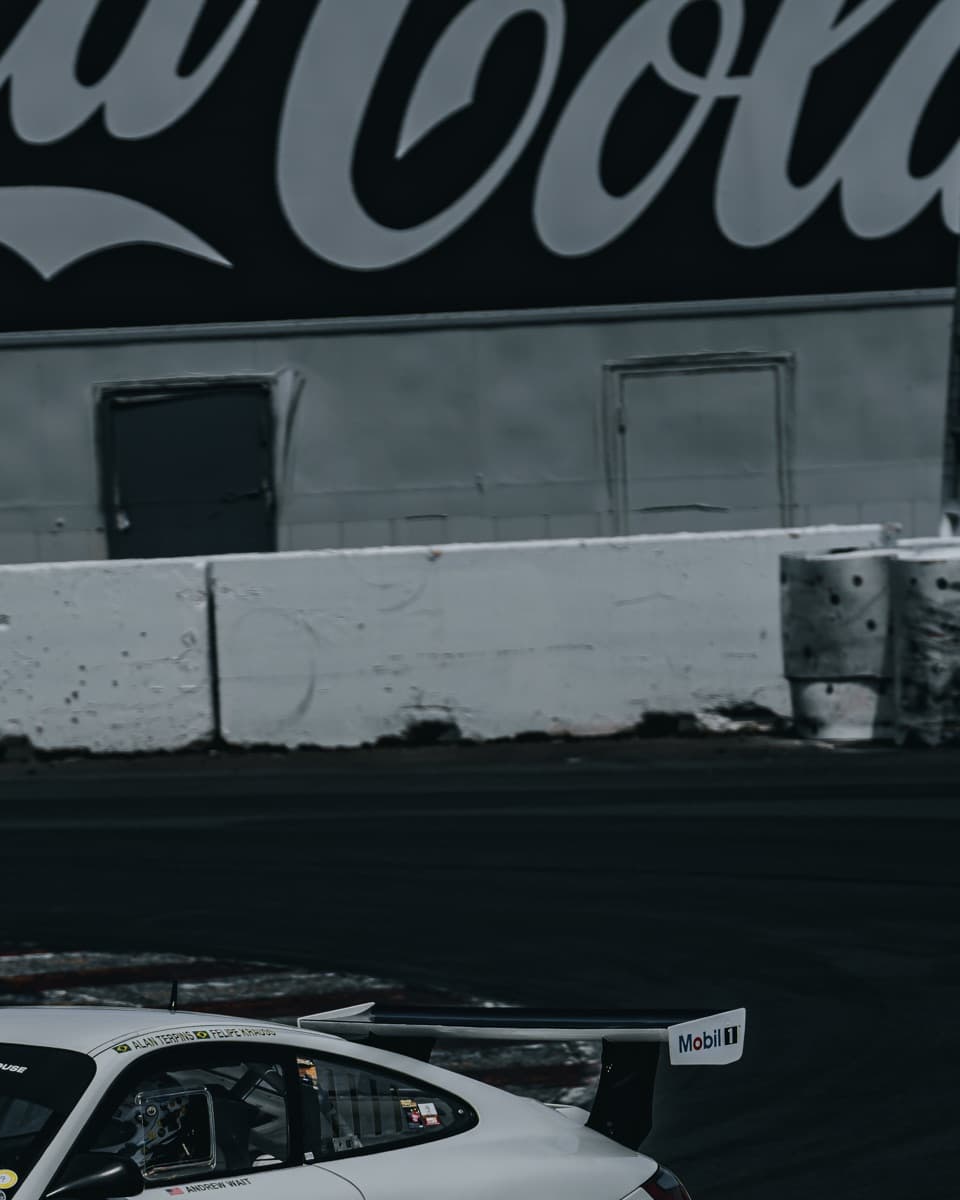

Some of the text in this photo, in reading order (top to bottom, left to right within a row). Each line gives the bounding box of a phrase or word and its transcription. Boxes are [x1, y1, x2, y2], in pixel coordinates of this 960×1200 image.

[132, 1037, 157, 1050] ALAN
[157, 1031, 195, 1046] TERPINS
[210, 1028, 241, 1039] FELIPE
[678, 1028, 721, 1053] Mobil
[185, 1178, 253, 1194] ANDREW WAIT
